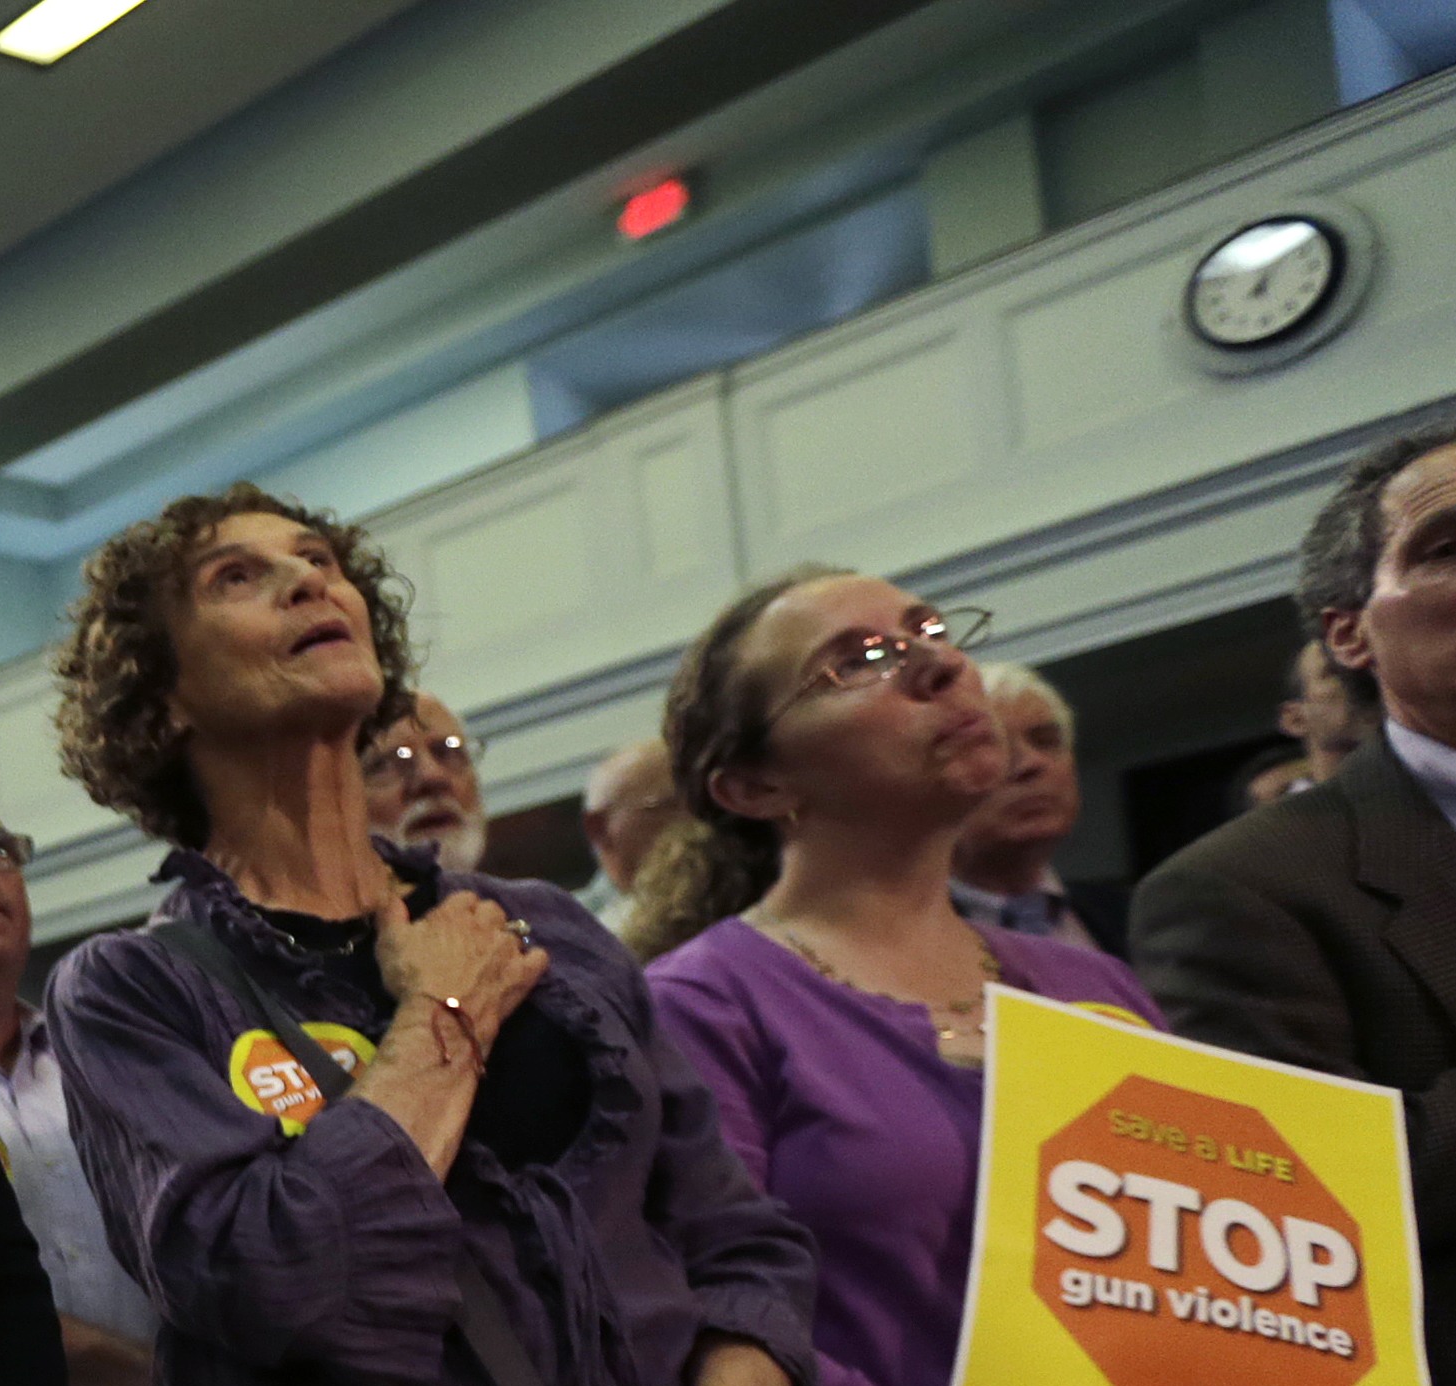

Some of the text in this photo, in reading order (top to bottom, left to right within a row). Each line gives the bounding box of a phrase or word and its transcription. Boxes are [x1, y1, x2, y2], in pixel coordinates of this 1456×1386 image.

[1194, 1135, 1218, 1161] a
[1225, 1145, 1293, 1182] LIFE
[1042, 1159, 1357, 1307] STOP
[1060, 1268, 1354, 1356] gun violence
